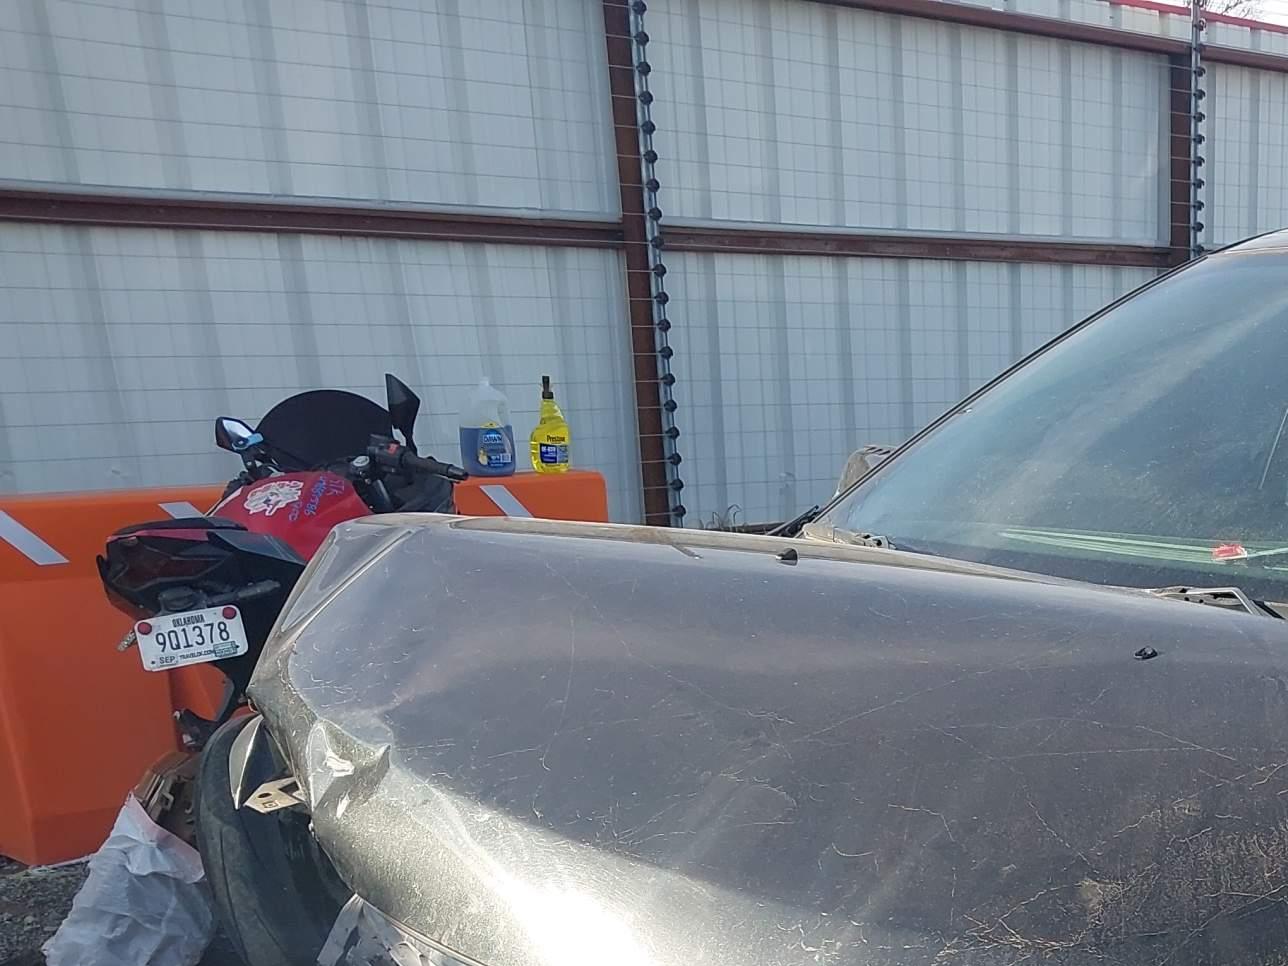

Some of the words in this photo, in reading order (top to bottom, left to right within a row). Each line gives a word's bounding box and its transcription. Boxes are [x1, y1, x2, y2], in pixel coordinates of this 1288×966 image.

[172, 614, 205, 627] OKLAHOMA
[156, 621, 230, 652] 9Q1378
[159, 656, 175, 664] SEP
